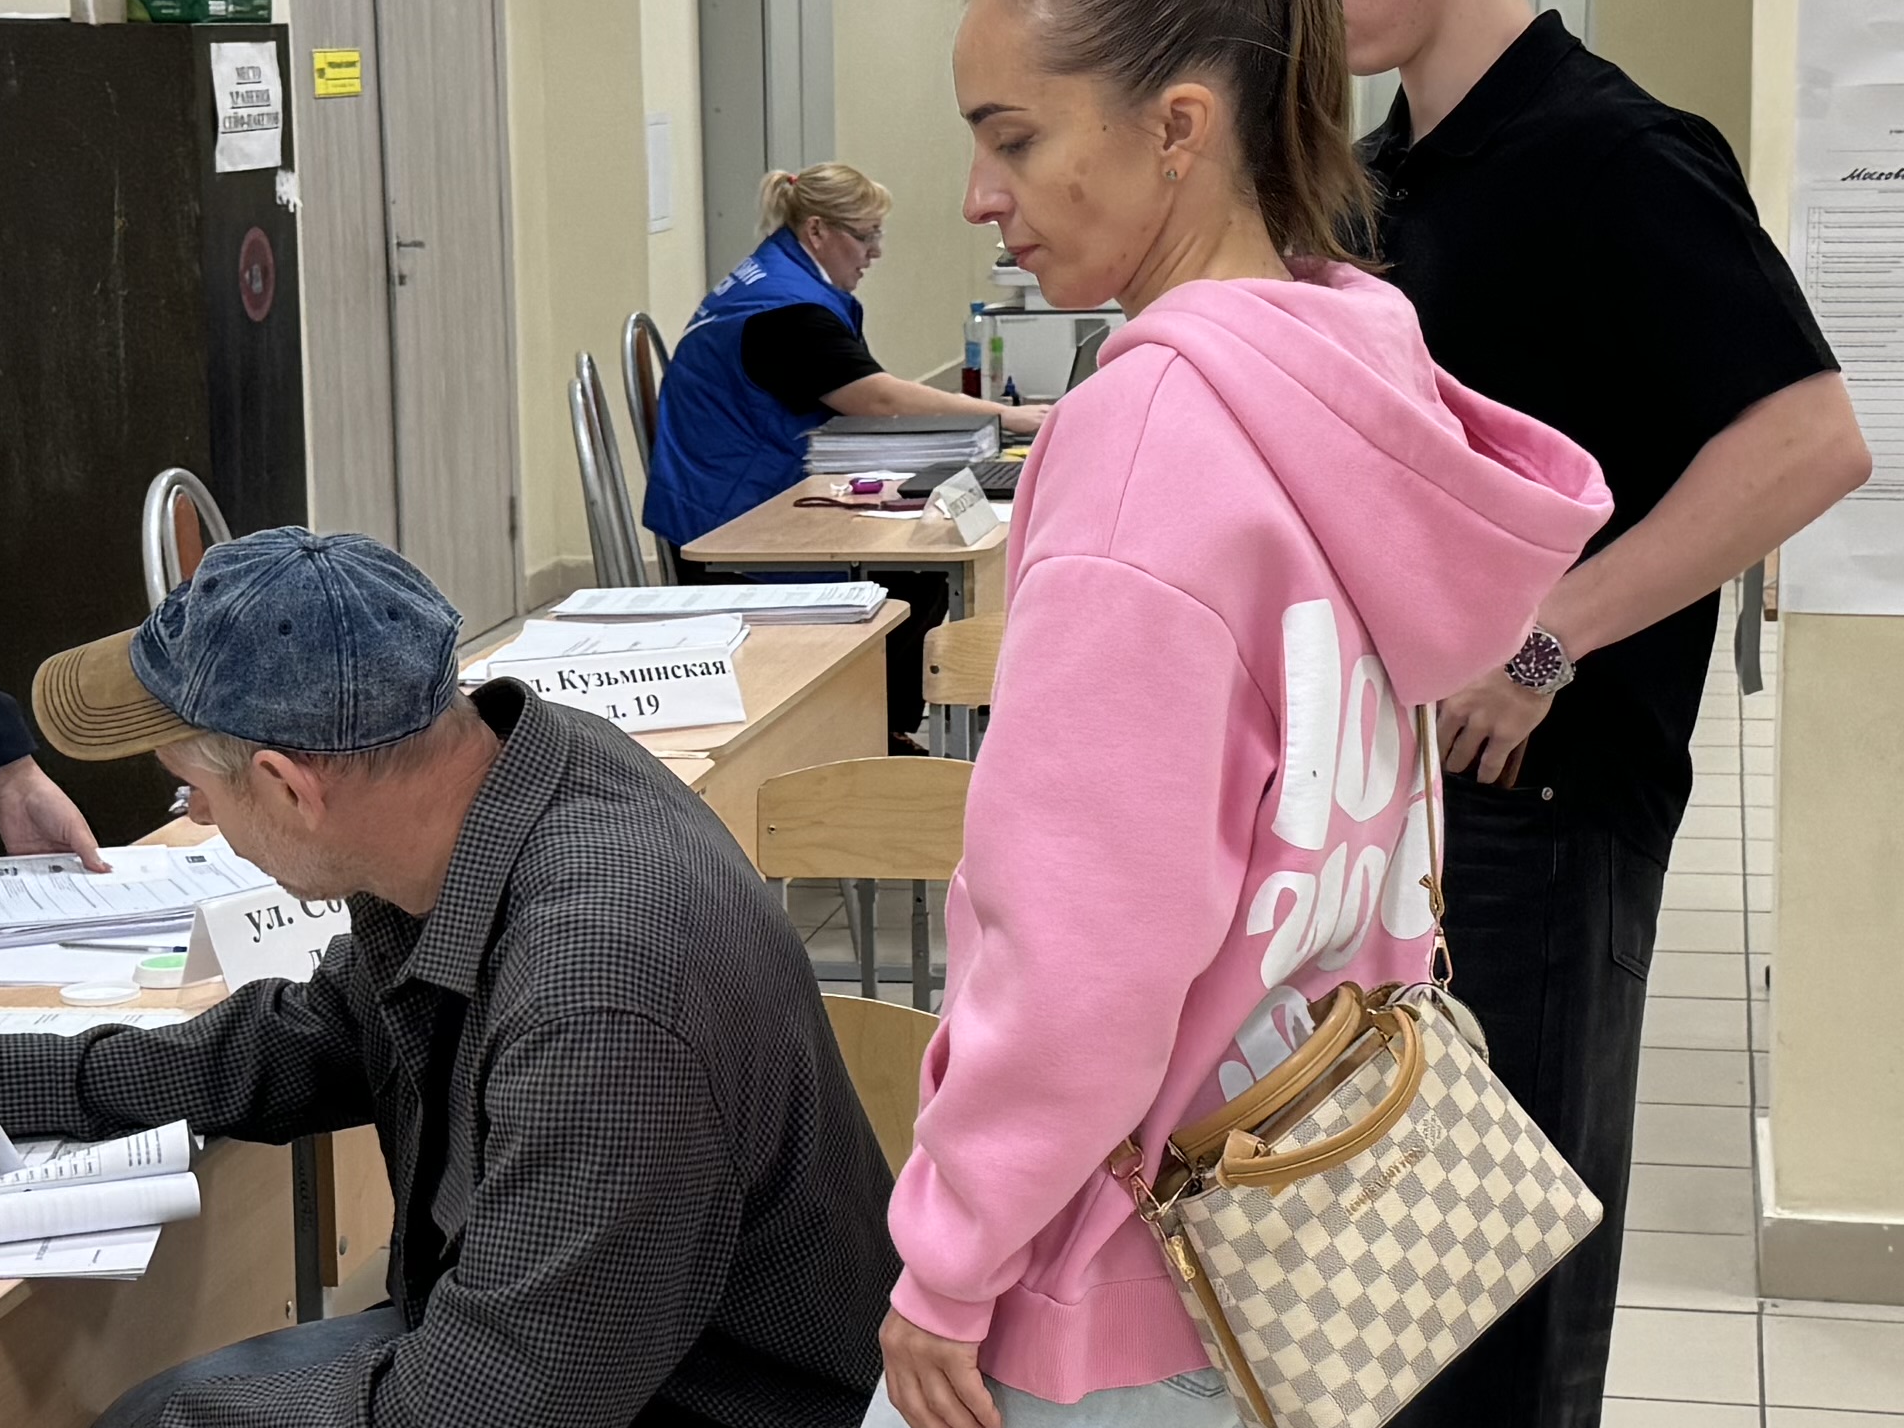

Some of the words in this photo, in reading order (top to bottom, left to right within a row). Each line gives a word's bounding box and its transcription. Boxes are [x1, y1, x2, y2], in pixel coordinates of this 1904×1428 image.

[530, 679, 551, 694] л.
[557, 660, 731, 694] Кузьминская
[605, 704, 627, 721] д.
[634, 694, 661, 717] 19
[244, 905, 294, 943] ул.
